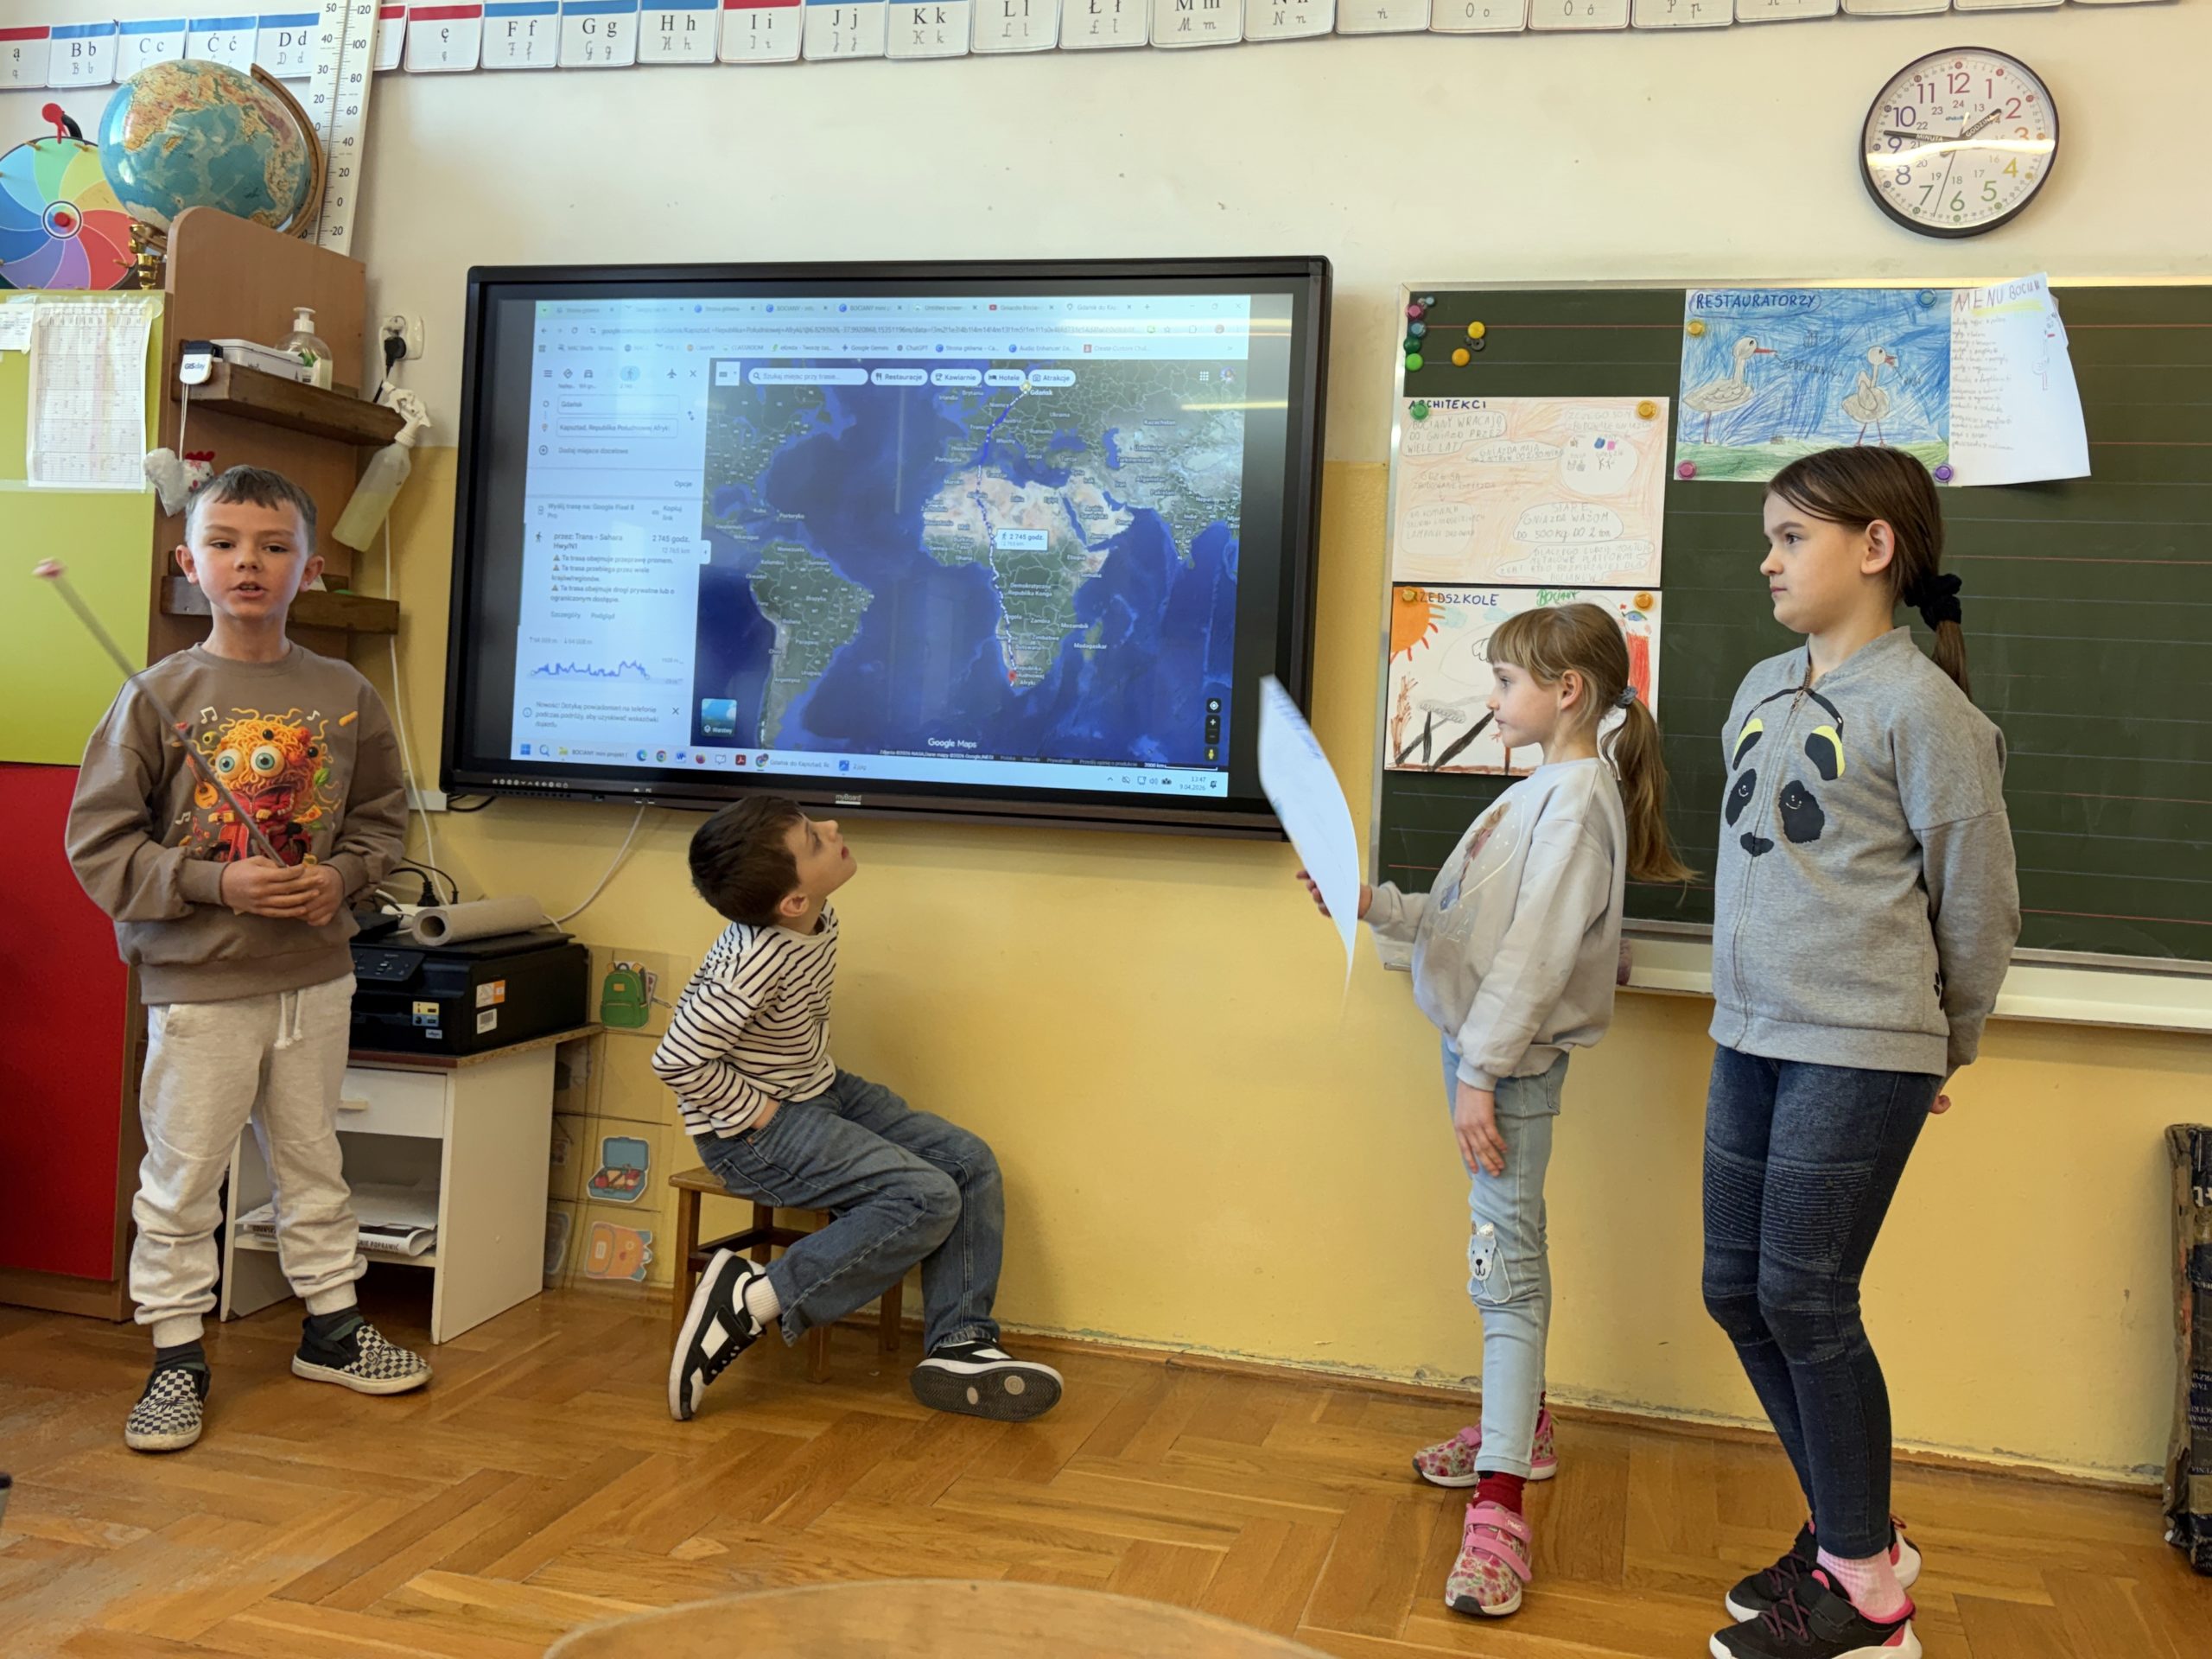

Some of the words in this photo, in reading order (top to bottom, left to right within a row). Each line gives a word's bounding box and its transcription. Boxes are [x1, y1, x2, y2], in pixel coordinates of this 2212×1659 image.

[326, 3, 337, 12] 50
[356, 5, 372, 15] 120
[1003, 0, 1016, 17] L
[1089, 0, 1103, 14] Ł
[1483, 9, 1491, 17] o
[660, 15, 674, 31] H
[686, 15, 696, 31] h
[751, 14, 757, 30] I
[766, 13, 772, 29] i
[832, 10, 841, 27] J
[850, 8, 858, 30] j
[913, 9, 927, 25] K
[936, 7, 946, 24] k
[1272, 11, 1286, 26] N
[1296, 15, 1306, 24] n
[441, 27, 449, 42] ę
[506, 21, 518, 37] F
[528, 19, 537, 36] f
[582, 17, 596, 34] G
[607, 21, 617, 38] g
[139, 37, 151, 54] C
[156, 40, 164, 53] c
[207, 32, 219, 53] Ć
[228, 35, 238, 52] ć
[278, 32, 292, 48] D
[297, 30, 307, 46] d
[321, 34, 333, 43] 40
[352, 40, 366, 49] 100
[13, 48, 21, 62] ą
[71, 42, 82, 58] B
[88, 41, 97, 57] b
[317, 65, 328, 73] 30
[350, 73, 362, 83] 80
[1947, 72, 1970, 95] 12
[1986, 78, 1993, 99] 1
[1916, 82, 1936, 105] 11
[314, 94, 324, 104] 20
[346, 105, 358, 115] 60
[1931, 106, 1943, 115] 23
[1974, 103, 1985, 112] 13
[2005, 98, 2022, 119] 2
[1893, 105, 1916, 127] 10
[1916, 122, 1928, 130] 22
[2014, 126, 2029, 141] 3
[342, 137, 353, 146] 40
[1887, 135, 1903, 154] 9
[1916, 134, 1943, 143] MINUTA
[1916, 159, 1928, 168] 20
[1989, 155, 2000, 163] 16
[339, 168, 350, 177] 20
[1895, 165, 1911, 185] 8
[1974, 169, 1985, 178] 17
[2003, 158, 2018, 178] 4
[1931, 172, 1942, 181] 19
[1951, 175, 1962, 184] 18
[1919, 184, 1934, 206] 7
[1980, 181, 1998, 202] 5
[336, 197, 343, 207] 0
[1949, 190, 1965, 212] 6
[330, 226, 343, 236] -20
[1696, 294, 1815, 309] RESTAURATORZY
[1953, 288, 2005, 313] MENU
[885, 372, 923, 382] Restauracje
[998, 373, 1020, 382] Hotele
[1042, 374, 1071, 383] Atrakcje
[1573, 528, 1586, 537] DO
[1588, 527, 1595, 537] 2
[1405, 593, 1500, 607] RZEDSZKOLE
[928, 738, 955, 748] Google
[957, 741, 977, 749] Maps
